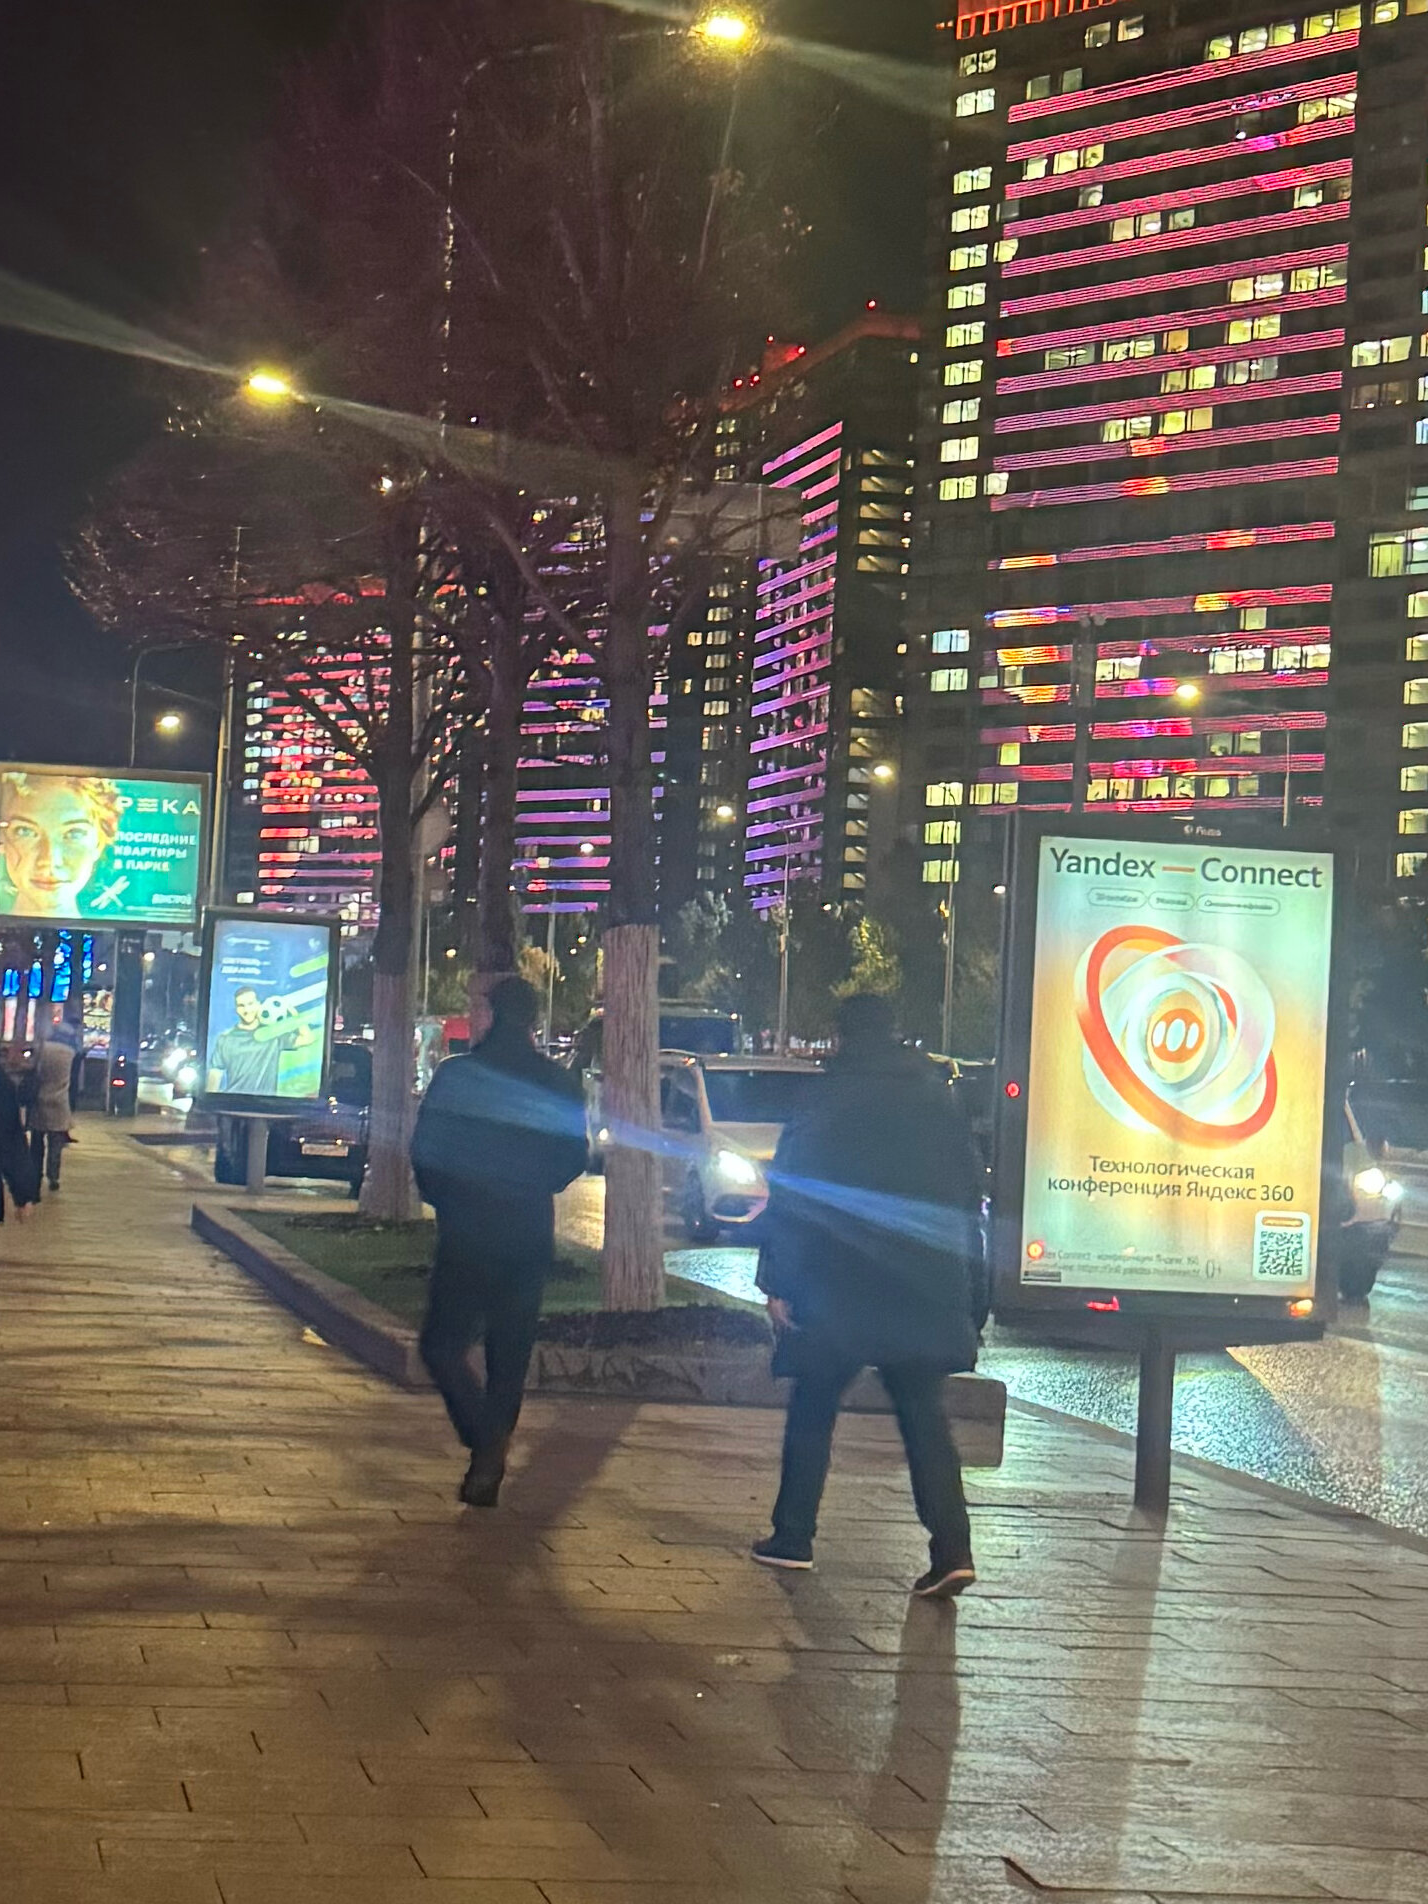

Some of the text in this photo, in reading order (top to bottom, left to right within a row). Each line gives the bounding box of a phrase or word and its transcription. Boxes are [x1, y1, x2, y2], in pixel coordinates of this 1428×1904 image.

[1049, 847, 1323, 889] Yandex Connect
[1089, 1155, 1256, 1181] Технологическая
[1048, 1176, 1295, 1202] конференция Яндекс 360
